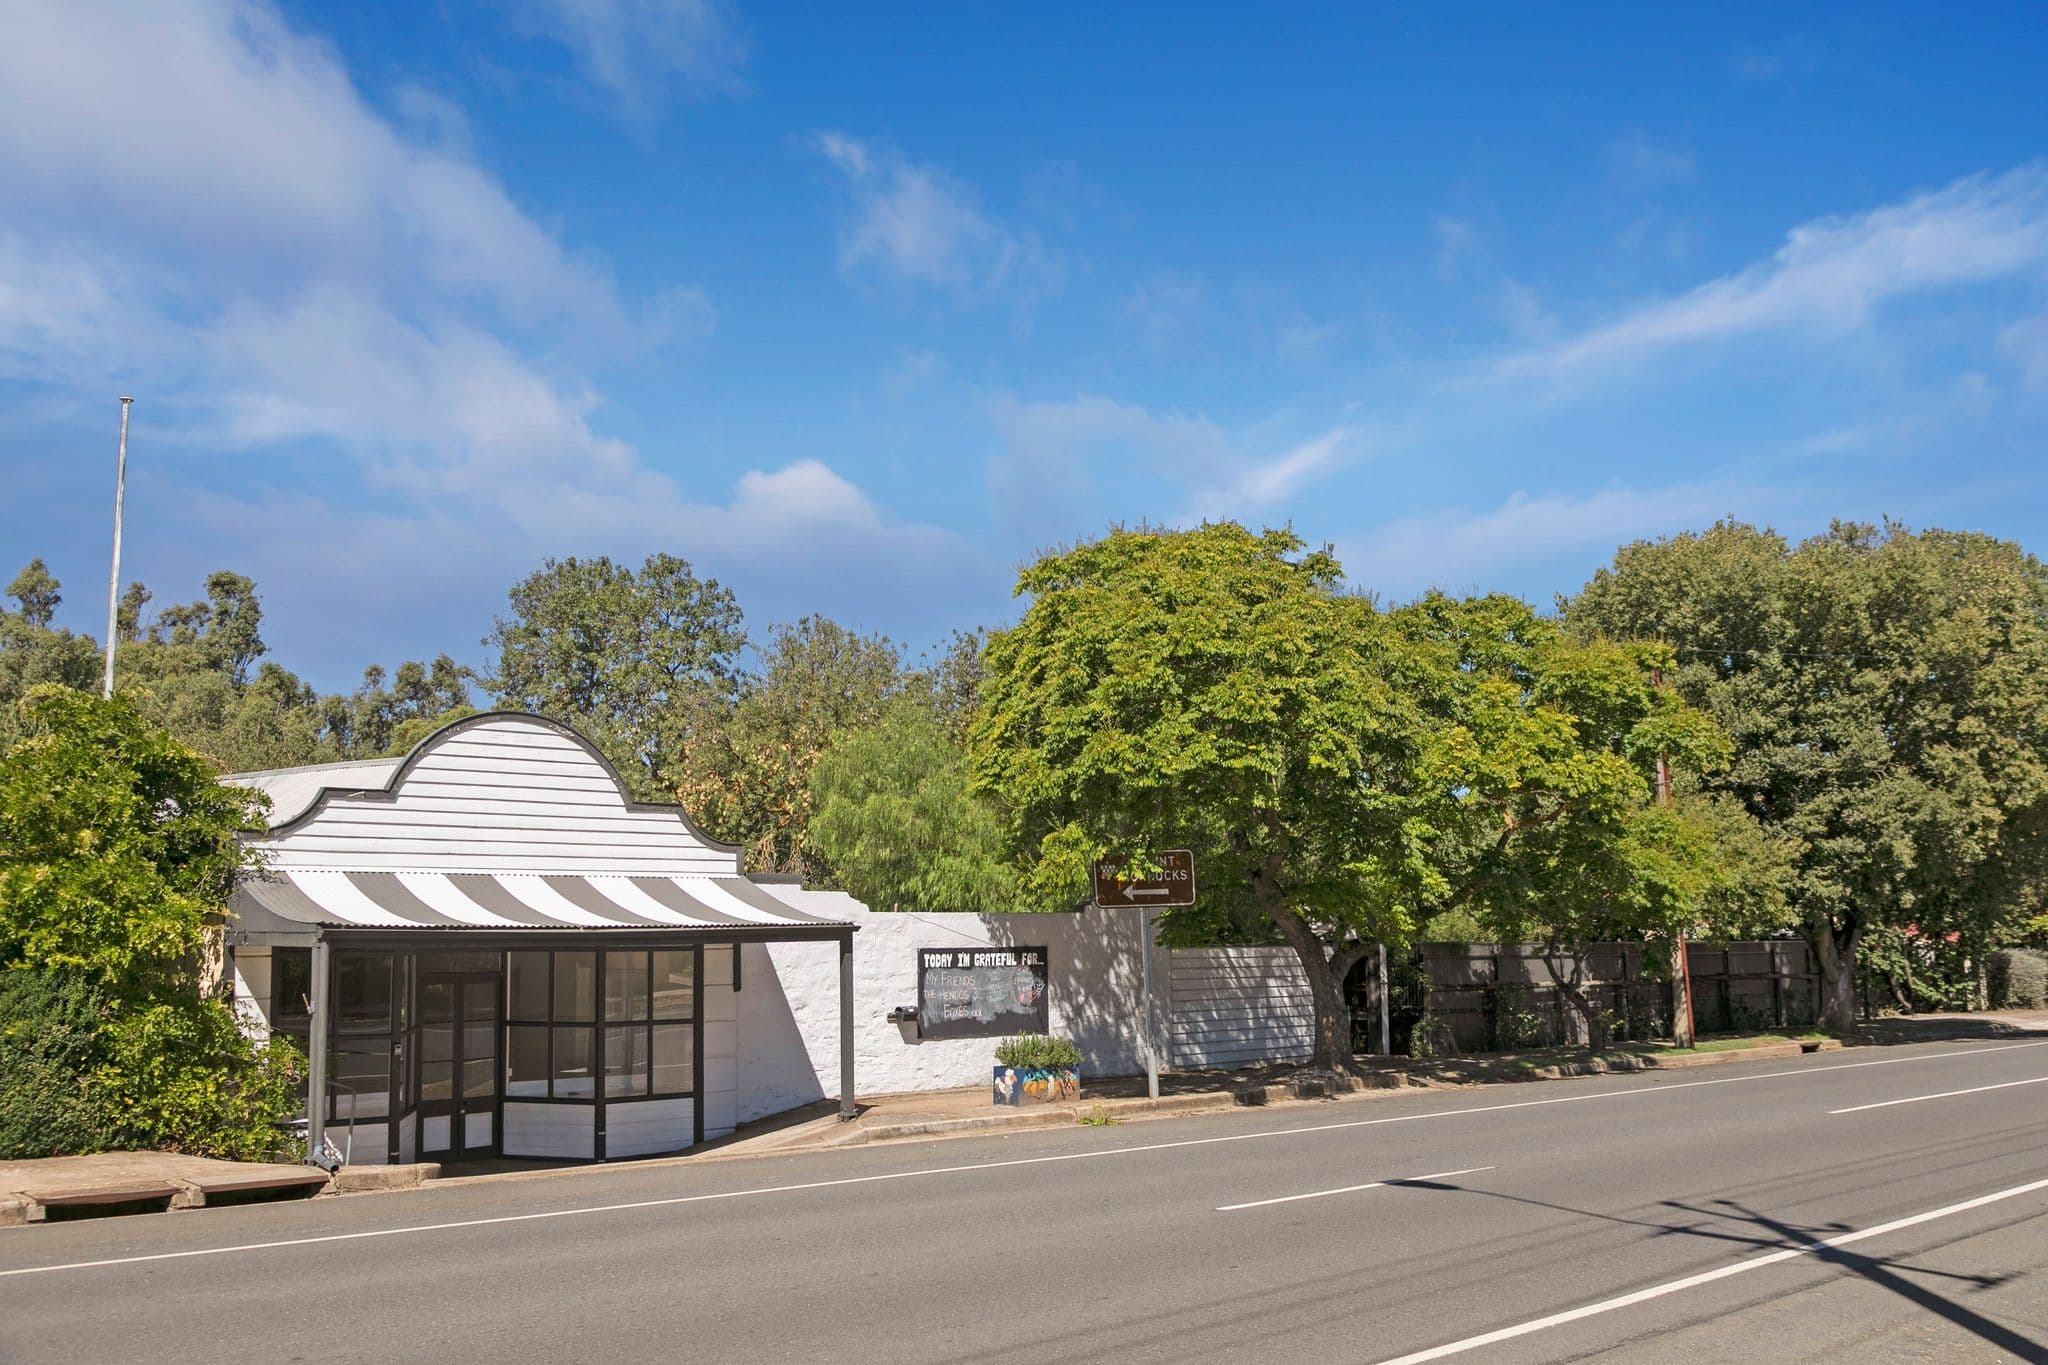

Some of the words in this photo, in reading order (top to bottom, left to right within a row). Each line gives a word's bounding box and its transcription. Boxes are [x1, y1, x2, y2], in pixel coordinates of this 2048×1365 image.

[924, 953, 953, 968] TODAY
[974, 952, 1017, 967] GRATEFUL
[941, 971, 976, 987] FRIENDS
